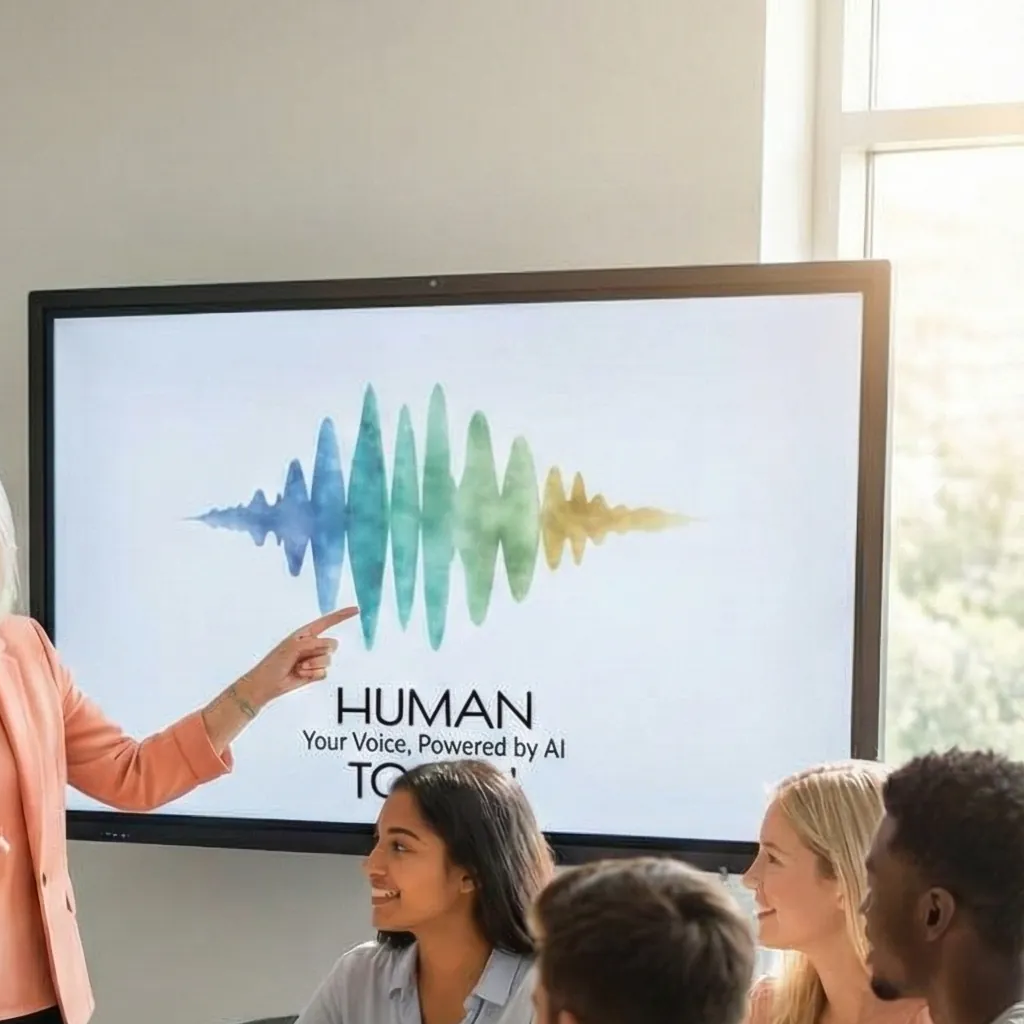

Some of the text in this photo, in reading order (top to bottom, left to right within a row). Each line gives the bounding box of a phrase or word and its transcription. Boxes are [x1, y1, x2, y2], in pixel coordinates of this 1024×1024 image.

[337, 687, 532, 730] HUMAN
[303, 730, 565, 762] Your Voice, Powered by AI
